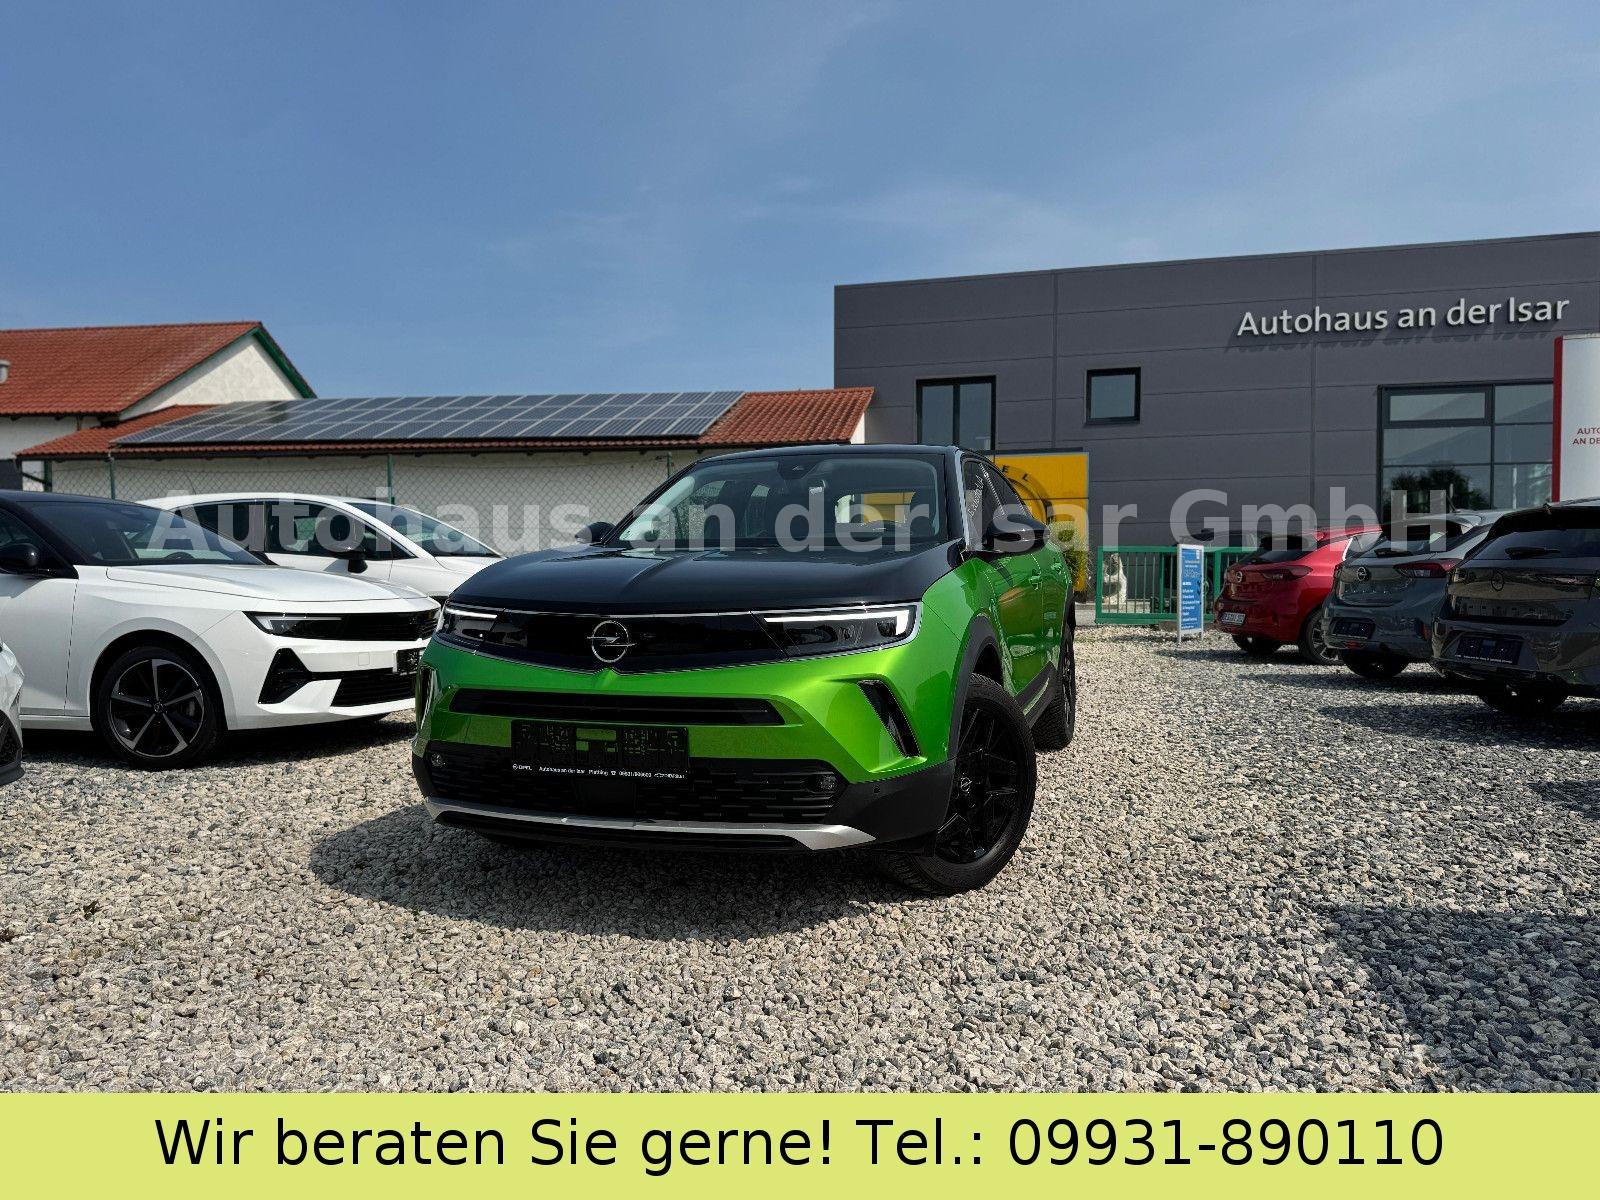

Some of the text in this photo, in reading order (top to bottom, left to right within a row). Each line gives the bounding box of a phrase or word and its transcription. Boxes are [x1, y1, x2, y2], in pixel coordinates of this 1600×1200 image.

[1237, 296, 1570, 336] Autohaus an der Isar
[1572, 437, 1587, 445] AN
